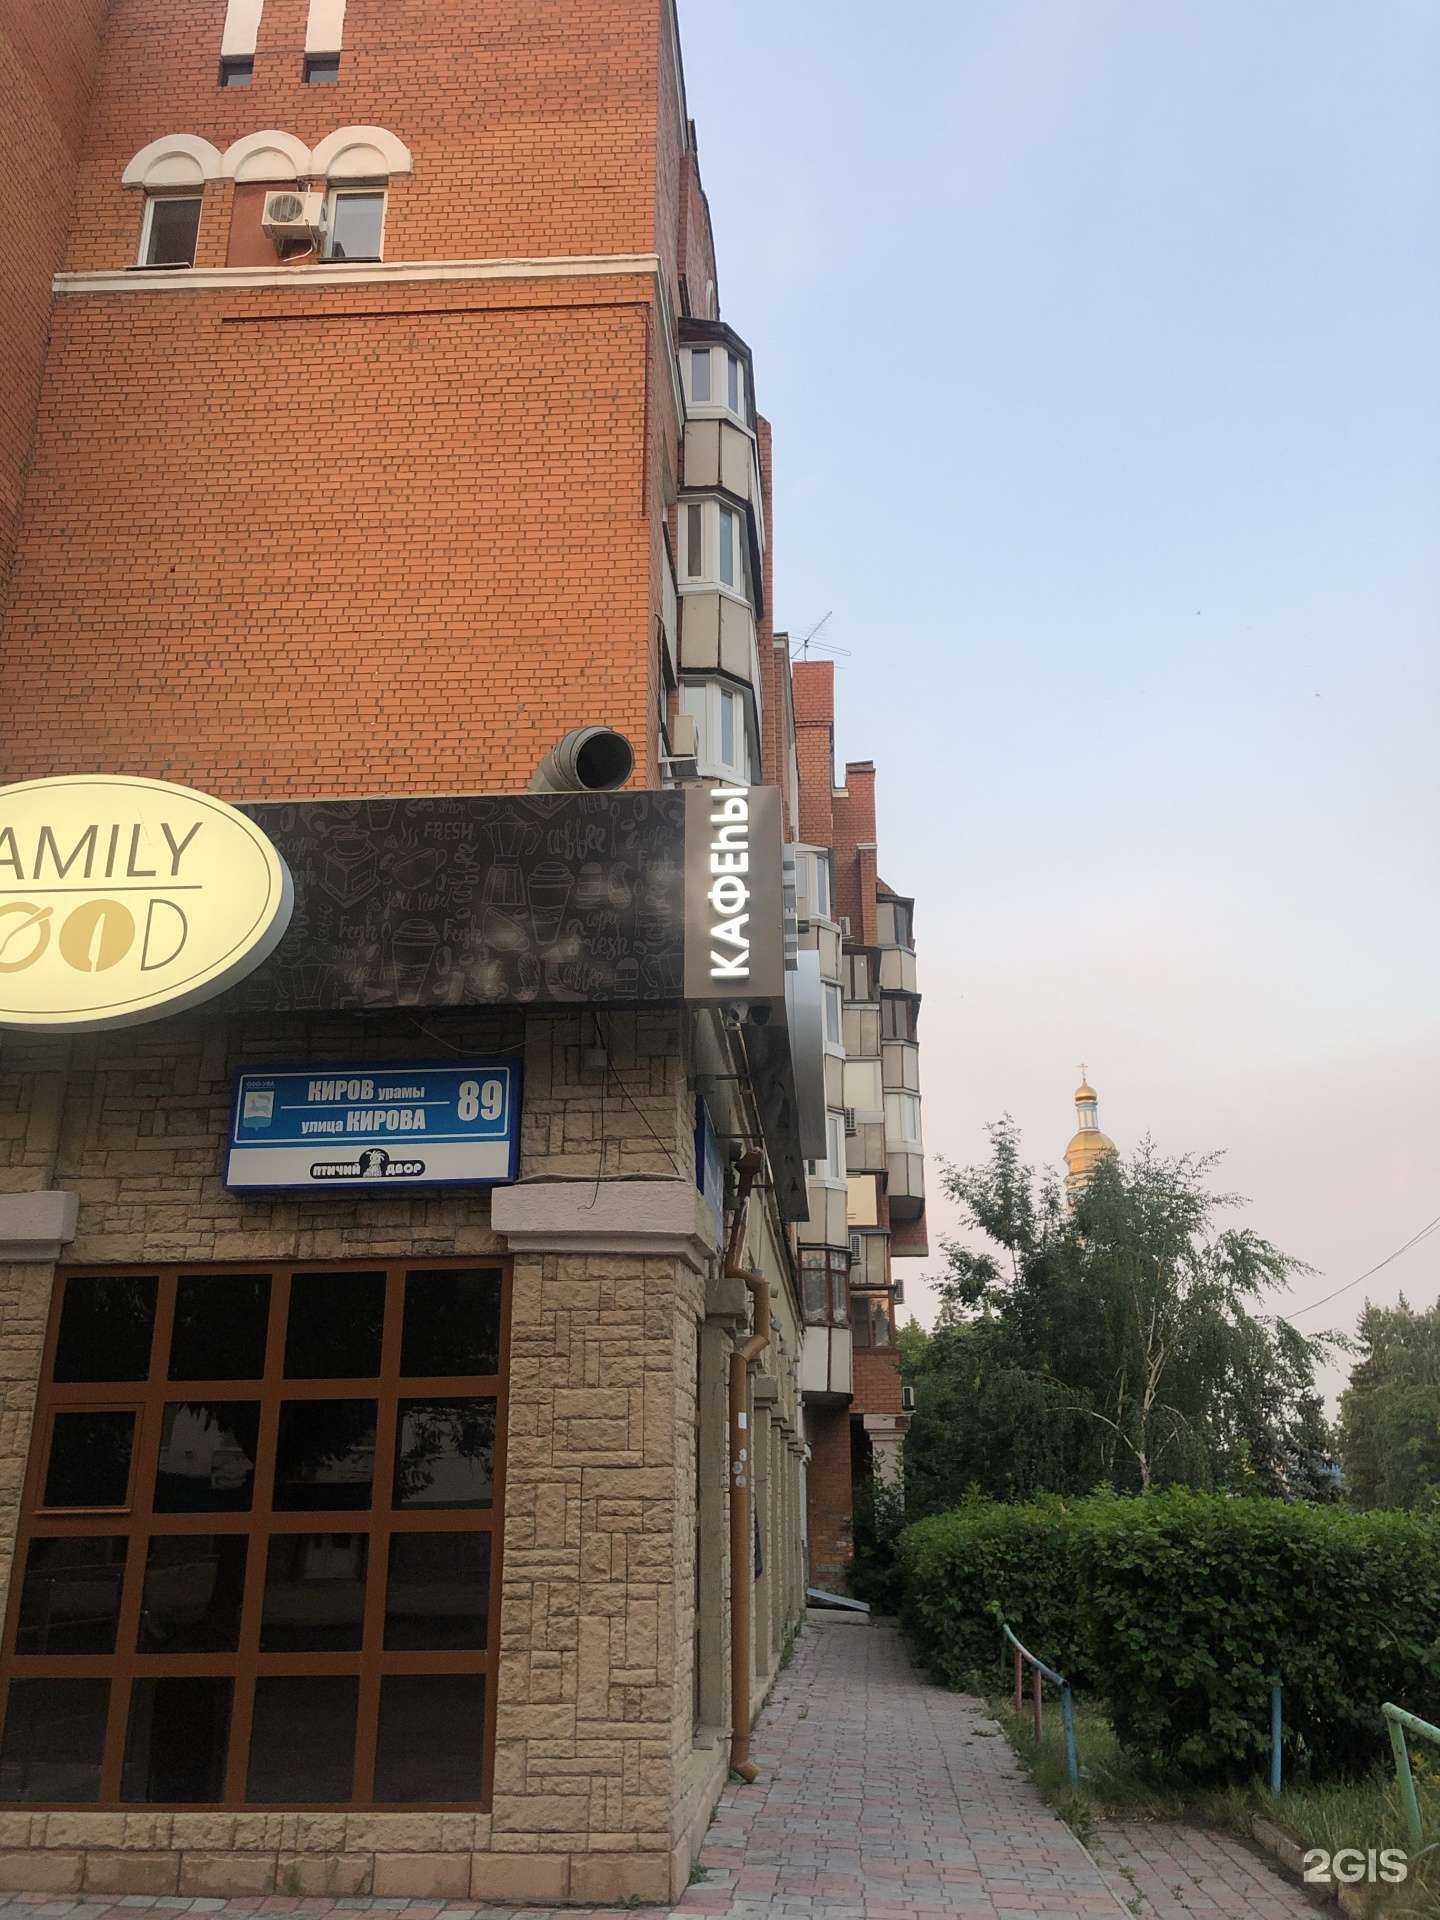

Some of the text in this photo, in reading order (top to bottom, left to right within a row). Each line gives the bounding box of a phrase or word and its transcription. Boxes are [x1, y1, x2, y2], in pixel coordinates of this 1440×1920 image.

[307, 1080, 425, 1101] КИРОВ урамы
[457, 1080, 503, 1122] 89
[301, 1109, 426, 1134] улица КИРОВА
